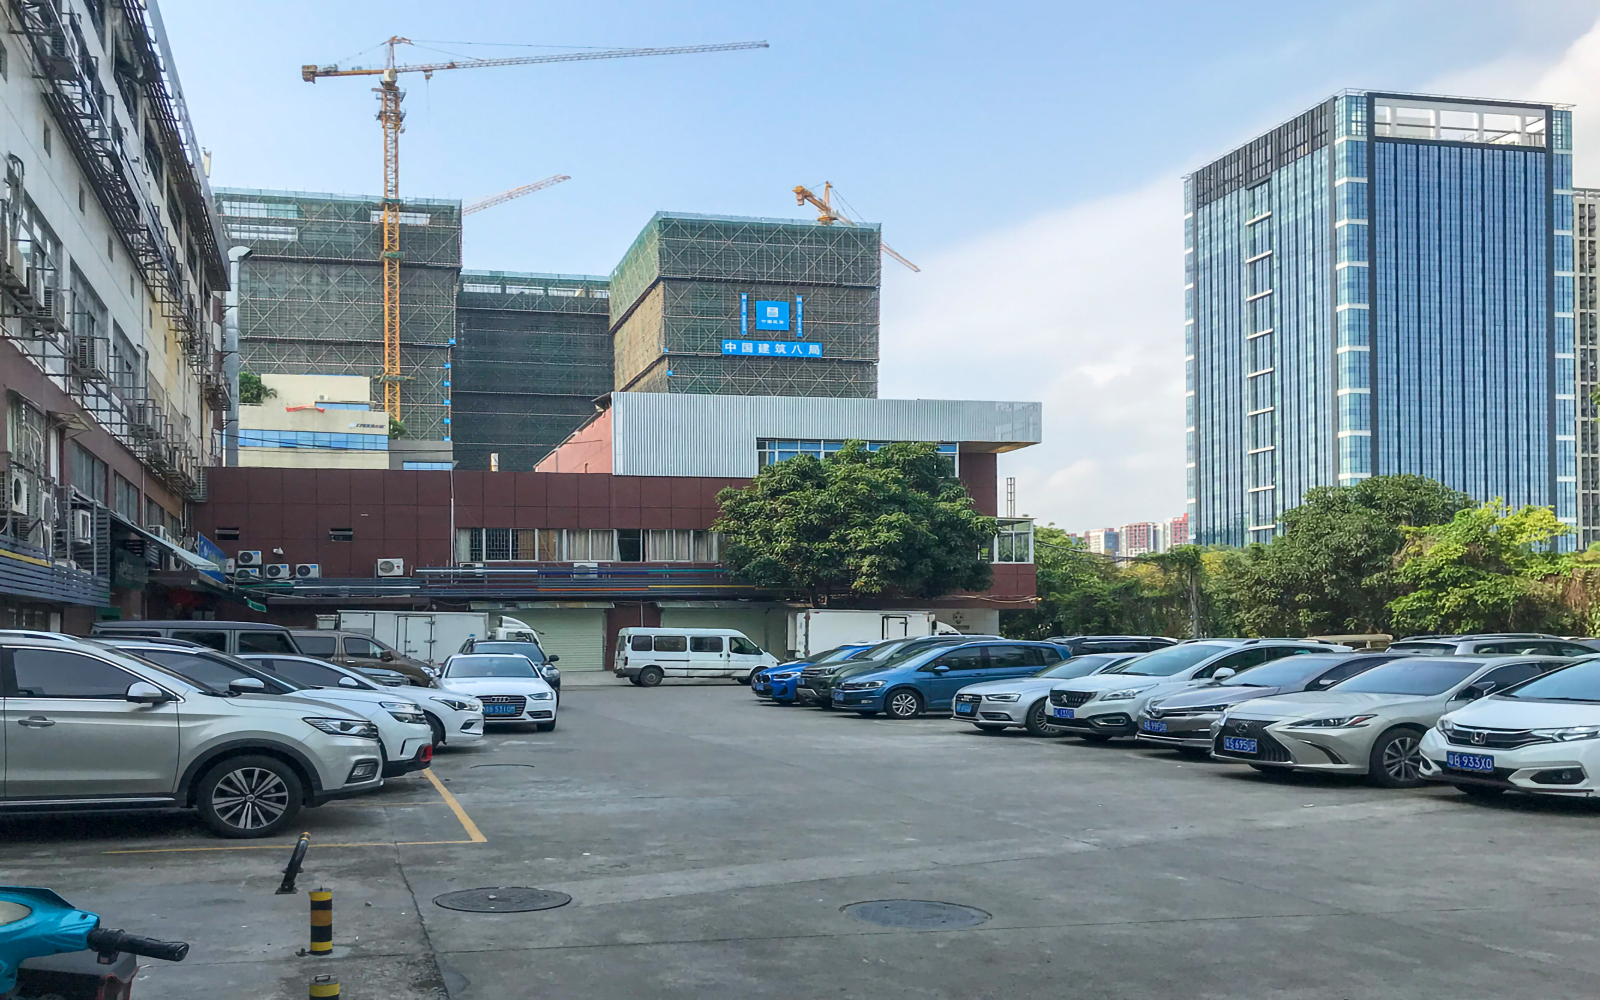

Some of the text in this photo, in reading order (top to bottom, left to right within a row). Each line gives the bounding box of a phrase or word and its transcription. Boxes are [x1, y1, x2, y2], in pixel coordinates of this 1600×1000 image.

[724, 341, 821, 356] 中国建筑八局
